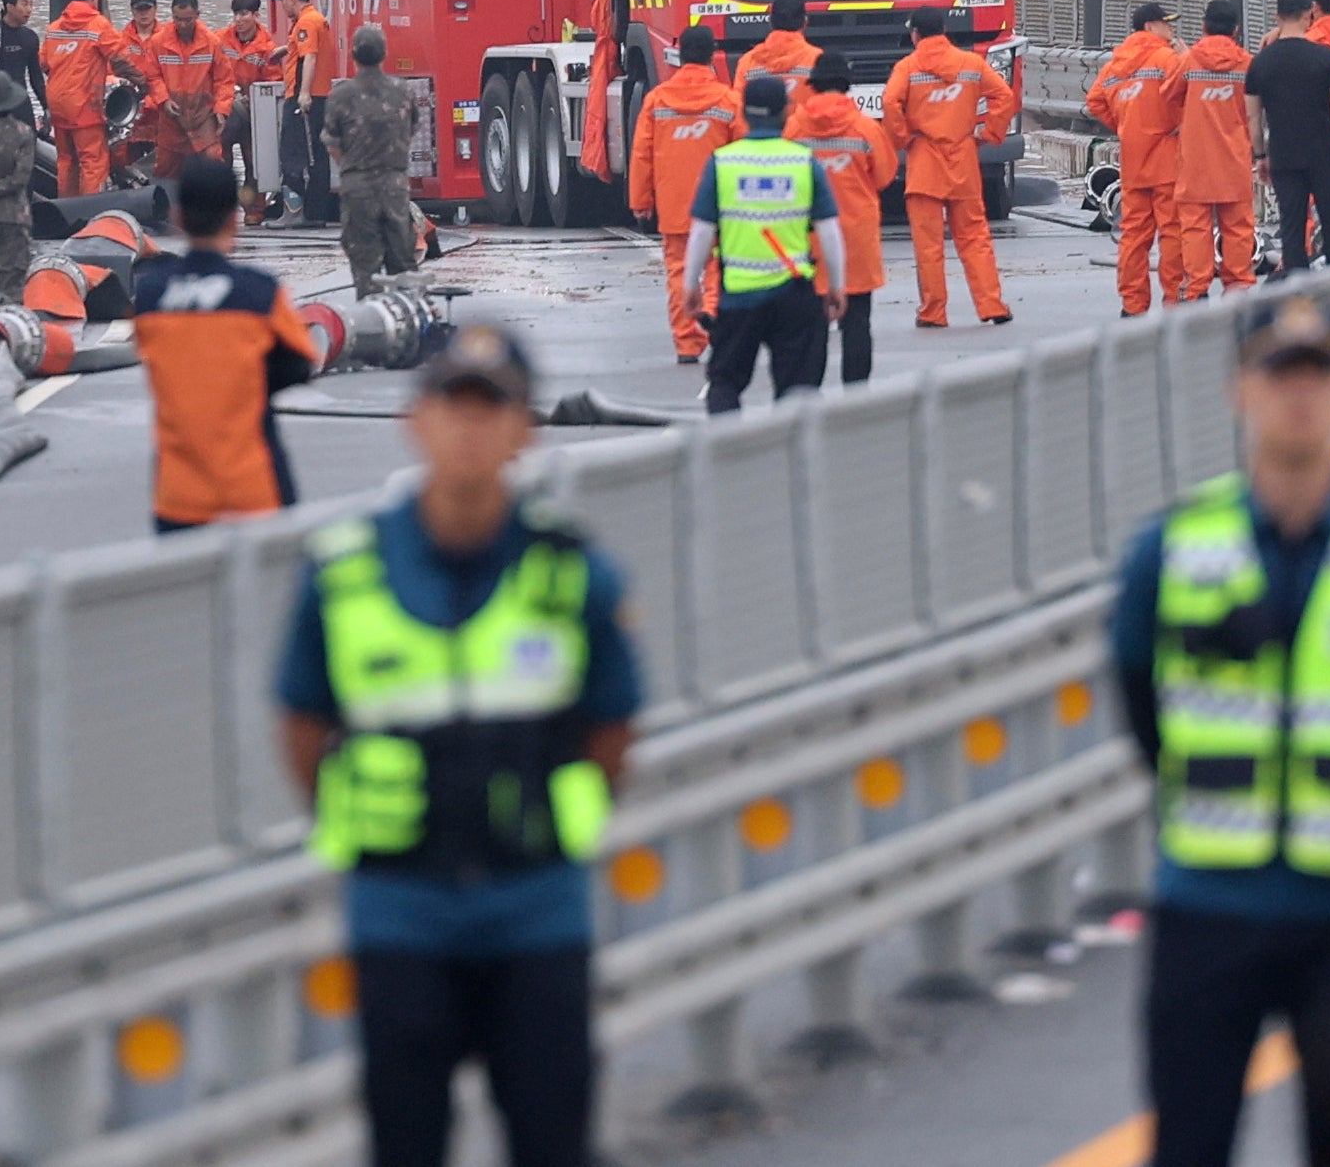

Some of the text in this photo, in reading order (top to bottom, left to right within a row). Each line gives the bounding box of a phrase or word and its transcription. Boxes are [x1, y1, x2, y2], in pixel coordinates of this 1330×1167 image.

[948, 9, 966, 17] FM
[927, 83, 962, 103] 119
[1200, 84, 1234, 101] 119
[852, 96, 883, 111] 940
[672, 120, 710, 140] 119
